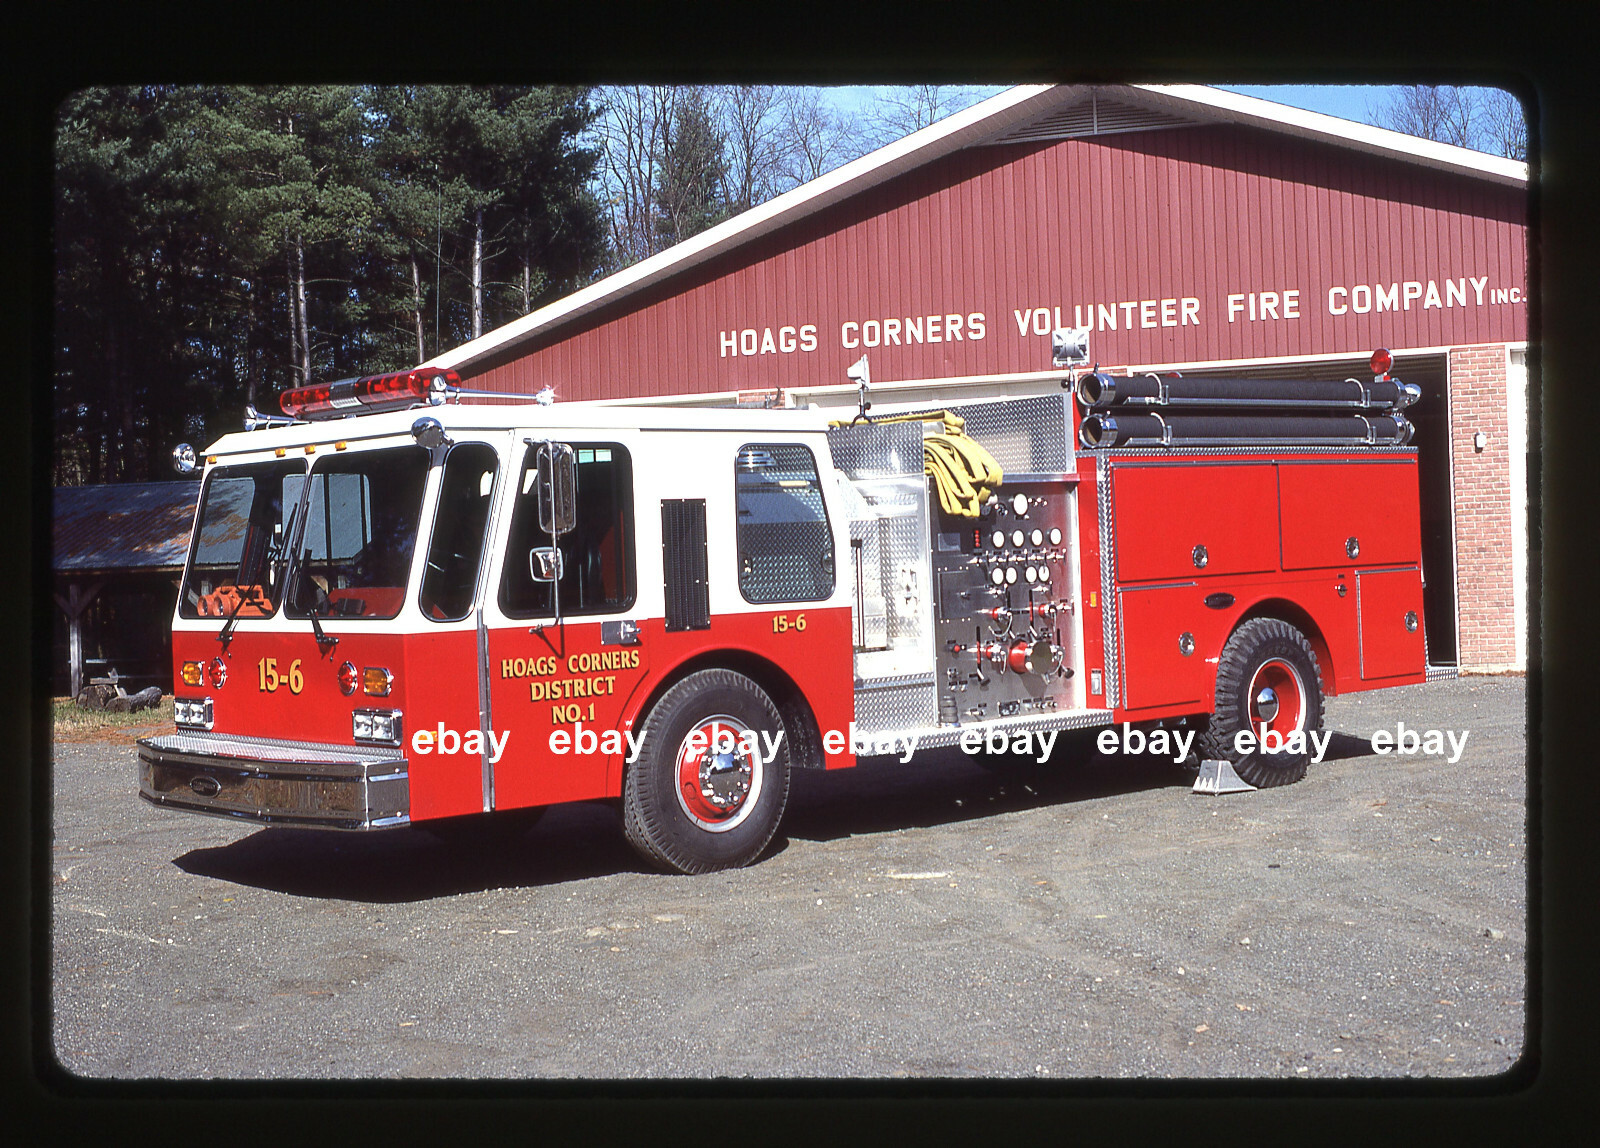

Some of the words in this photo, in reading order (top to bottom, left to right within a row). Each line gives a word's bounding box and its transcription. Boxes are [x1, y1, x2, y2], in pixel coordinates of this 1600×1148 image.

[720, 325, 817, 357] HOAGS
[841, 312, 987, 349] CORNERS
[1014, 297, 1201, 337] VOLUNTEER
[1227, 290, 1301, 323] FIRE
[1328, 276, 1488, 316] COMPANY
[1490, 287, 1528, 305] INC.
[772, 614, 807, 633] 15-6
[258, 656, 304, 695] 15-6
[501, 655, 558, 679] HOAGS
[567, 649, 641, 673] CORNERS
[530, 675, 616, 701] DISTRICT
[552, 702, 596, 724] NO.1
